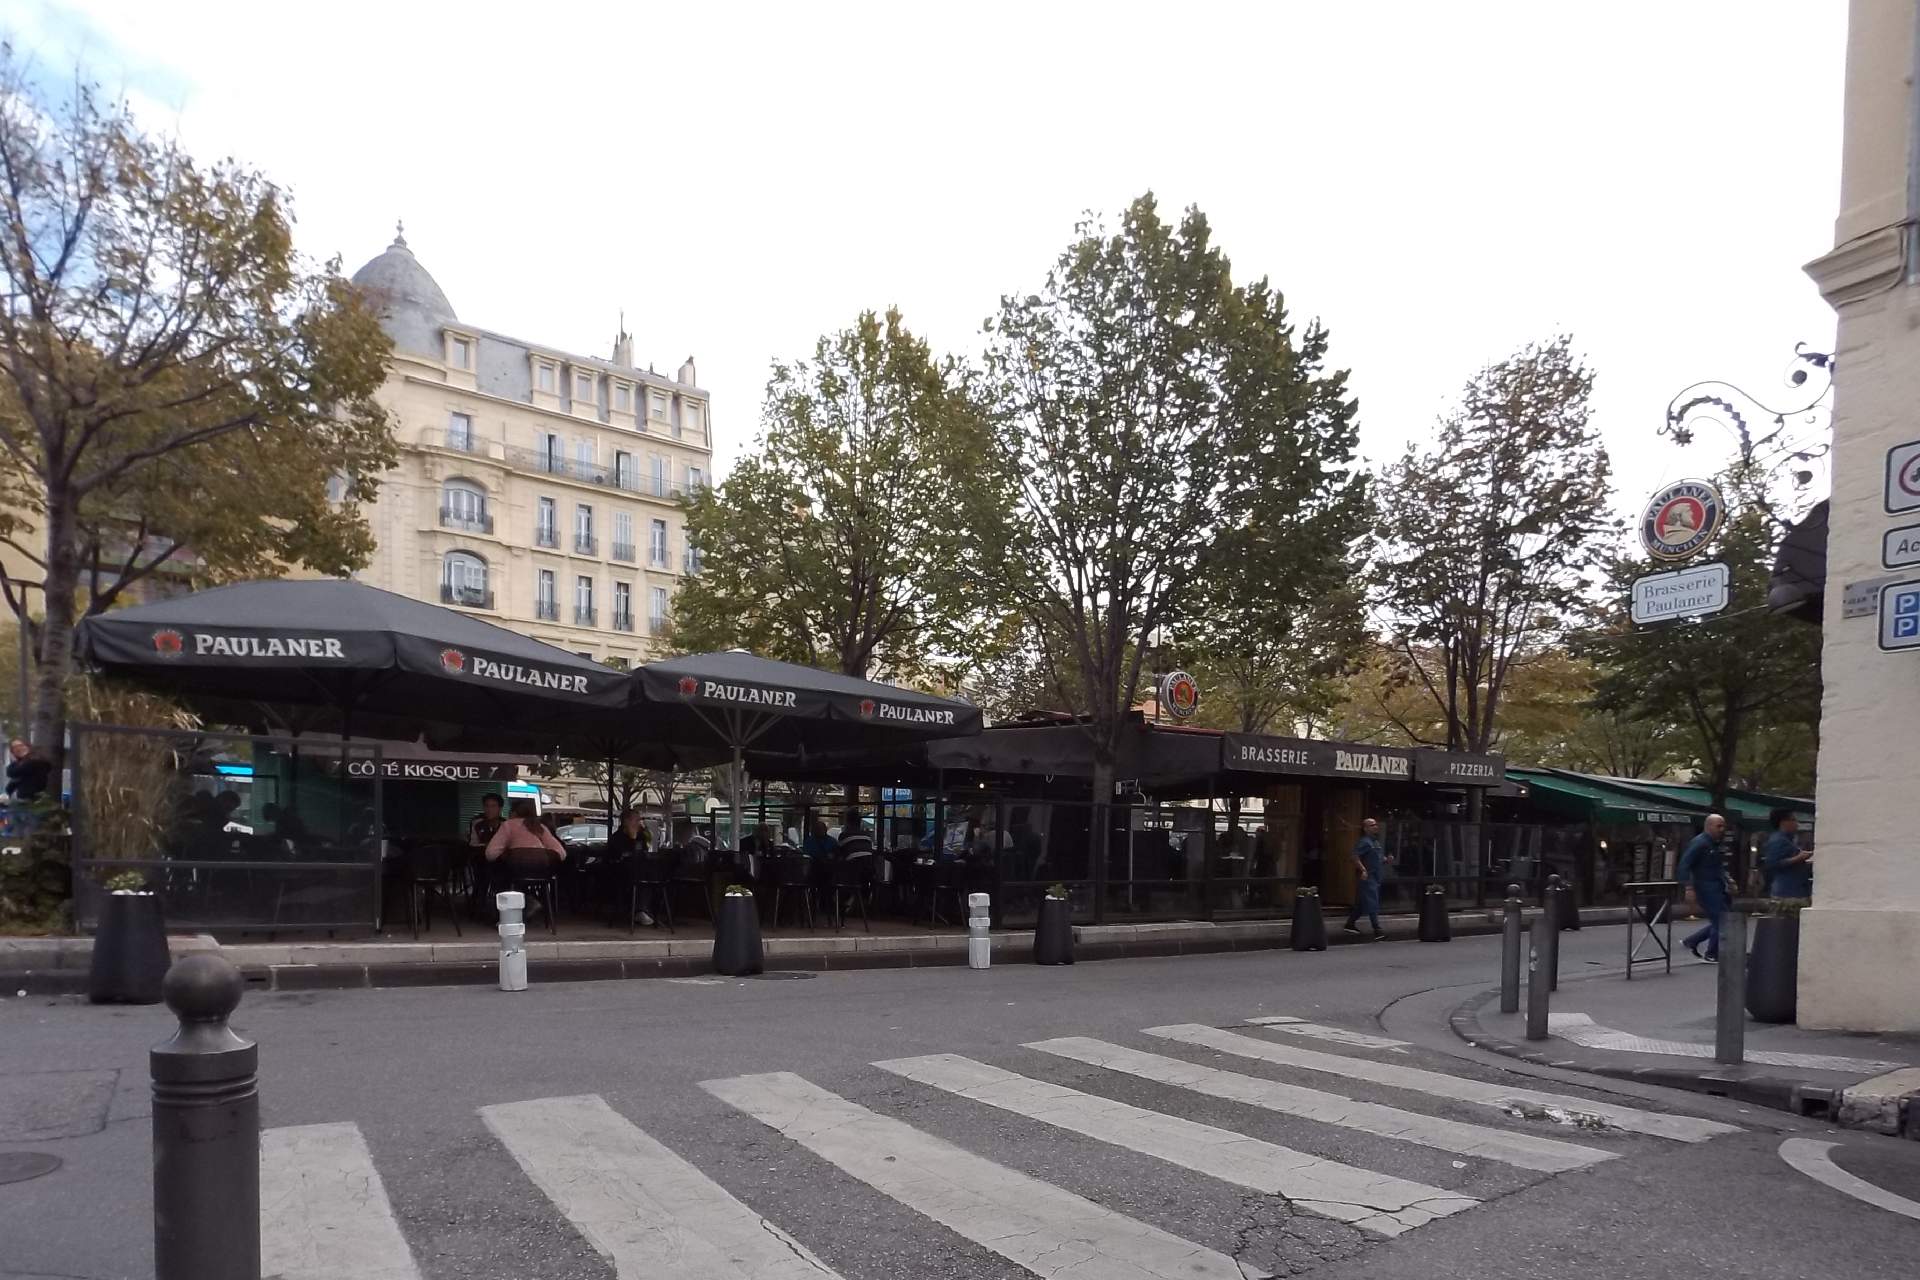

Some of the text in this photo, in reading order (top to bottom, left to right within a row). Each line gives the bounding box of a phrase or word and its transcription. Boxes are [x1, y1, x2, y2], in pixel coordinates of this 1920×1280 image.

[1648, 486, 1714, 521] PAULANER
[1643, 575, 1716, 599] Brasserie
[1646, 592, 1713, 615] Paulaner
[194, 634, 345, 658] PAULANER
[472, 656, 588, 694] PAULANER
[703, 681, 797, 708] PAULANER
[879, 703, 955, 725] PAULANER
[404, 764, 480, 780] KIOSQUE
[1241, 746, 1494, 777] BRASSERIE PAULANER PIZZERIA
